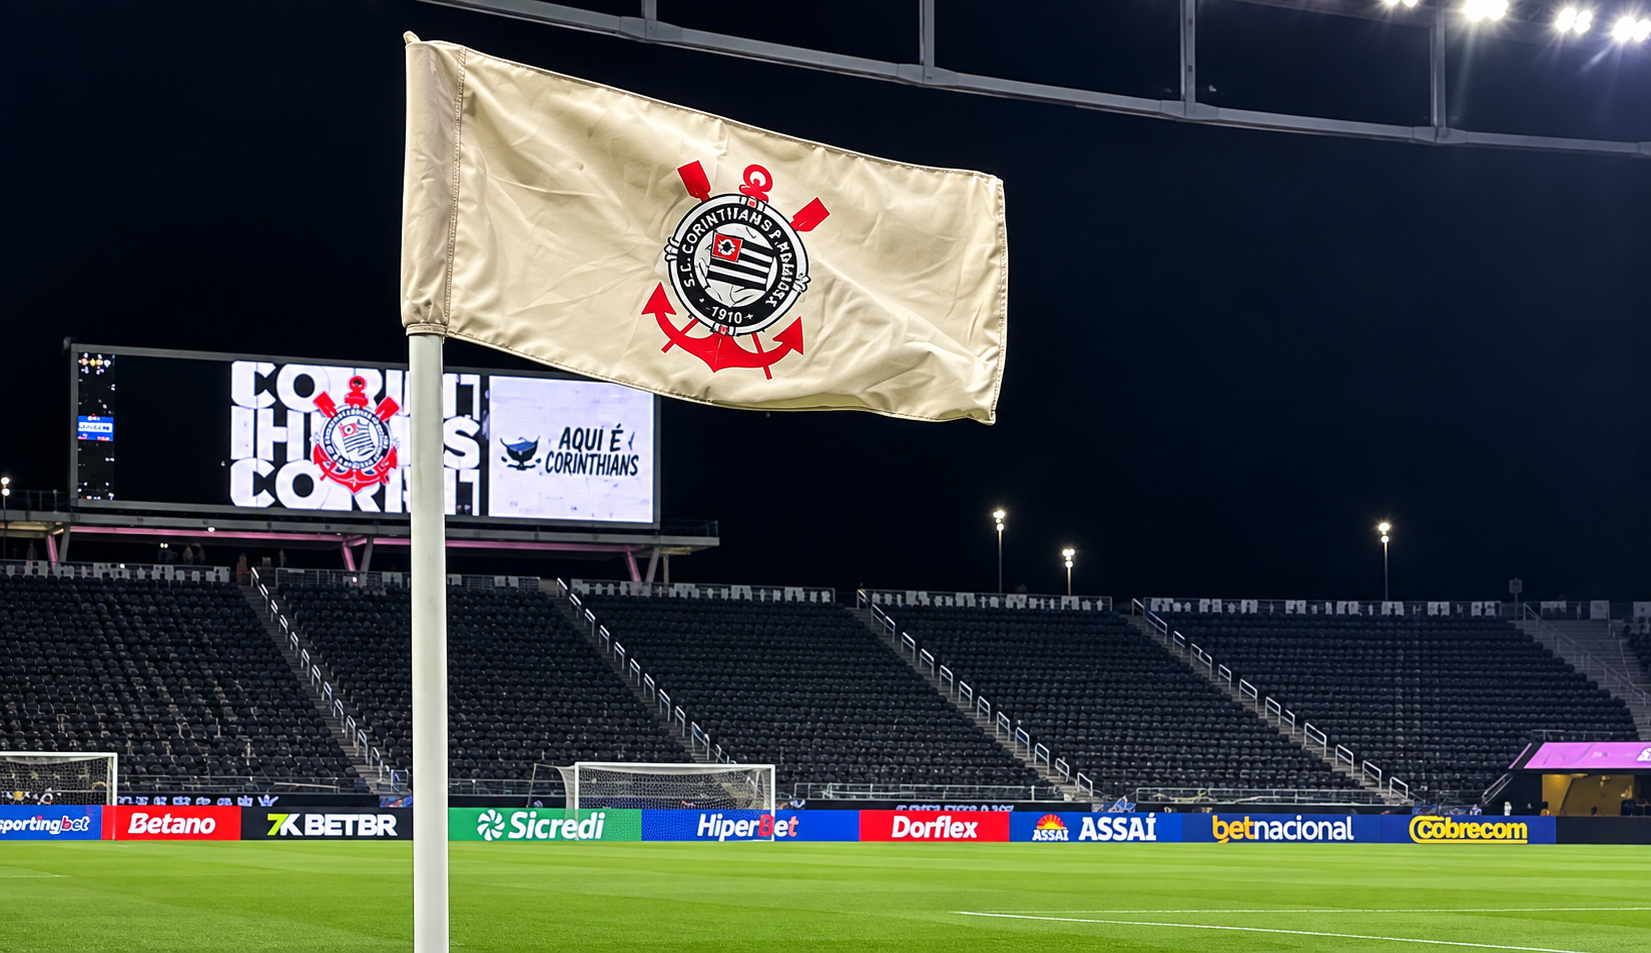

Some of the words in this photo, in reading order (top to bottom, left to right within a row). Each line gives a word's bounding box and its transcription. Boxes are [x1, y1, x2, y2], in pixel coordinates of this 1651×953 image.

[711, 306, 743, 324] 1910
[558, 426, 604, 452] AQUI
[609, 423, 624, 452] É
[545, 451, 639, 476] CORINTHIANS
[128, 812, 216, 834] Betano
[508, 810, 606, 839] Sicredi
[697, 813, 799, 842] HiperBet
[891, 815, 978, 838] Dorflex
[1078, 812, 1157, 841] ASSAÍ
[1212, 815, 1354, 844] betnacional
[1409, 815, 1528, 844] Cobrecom
